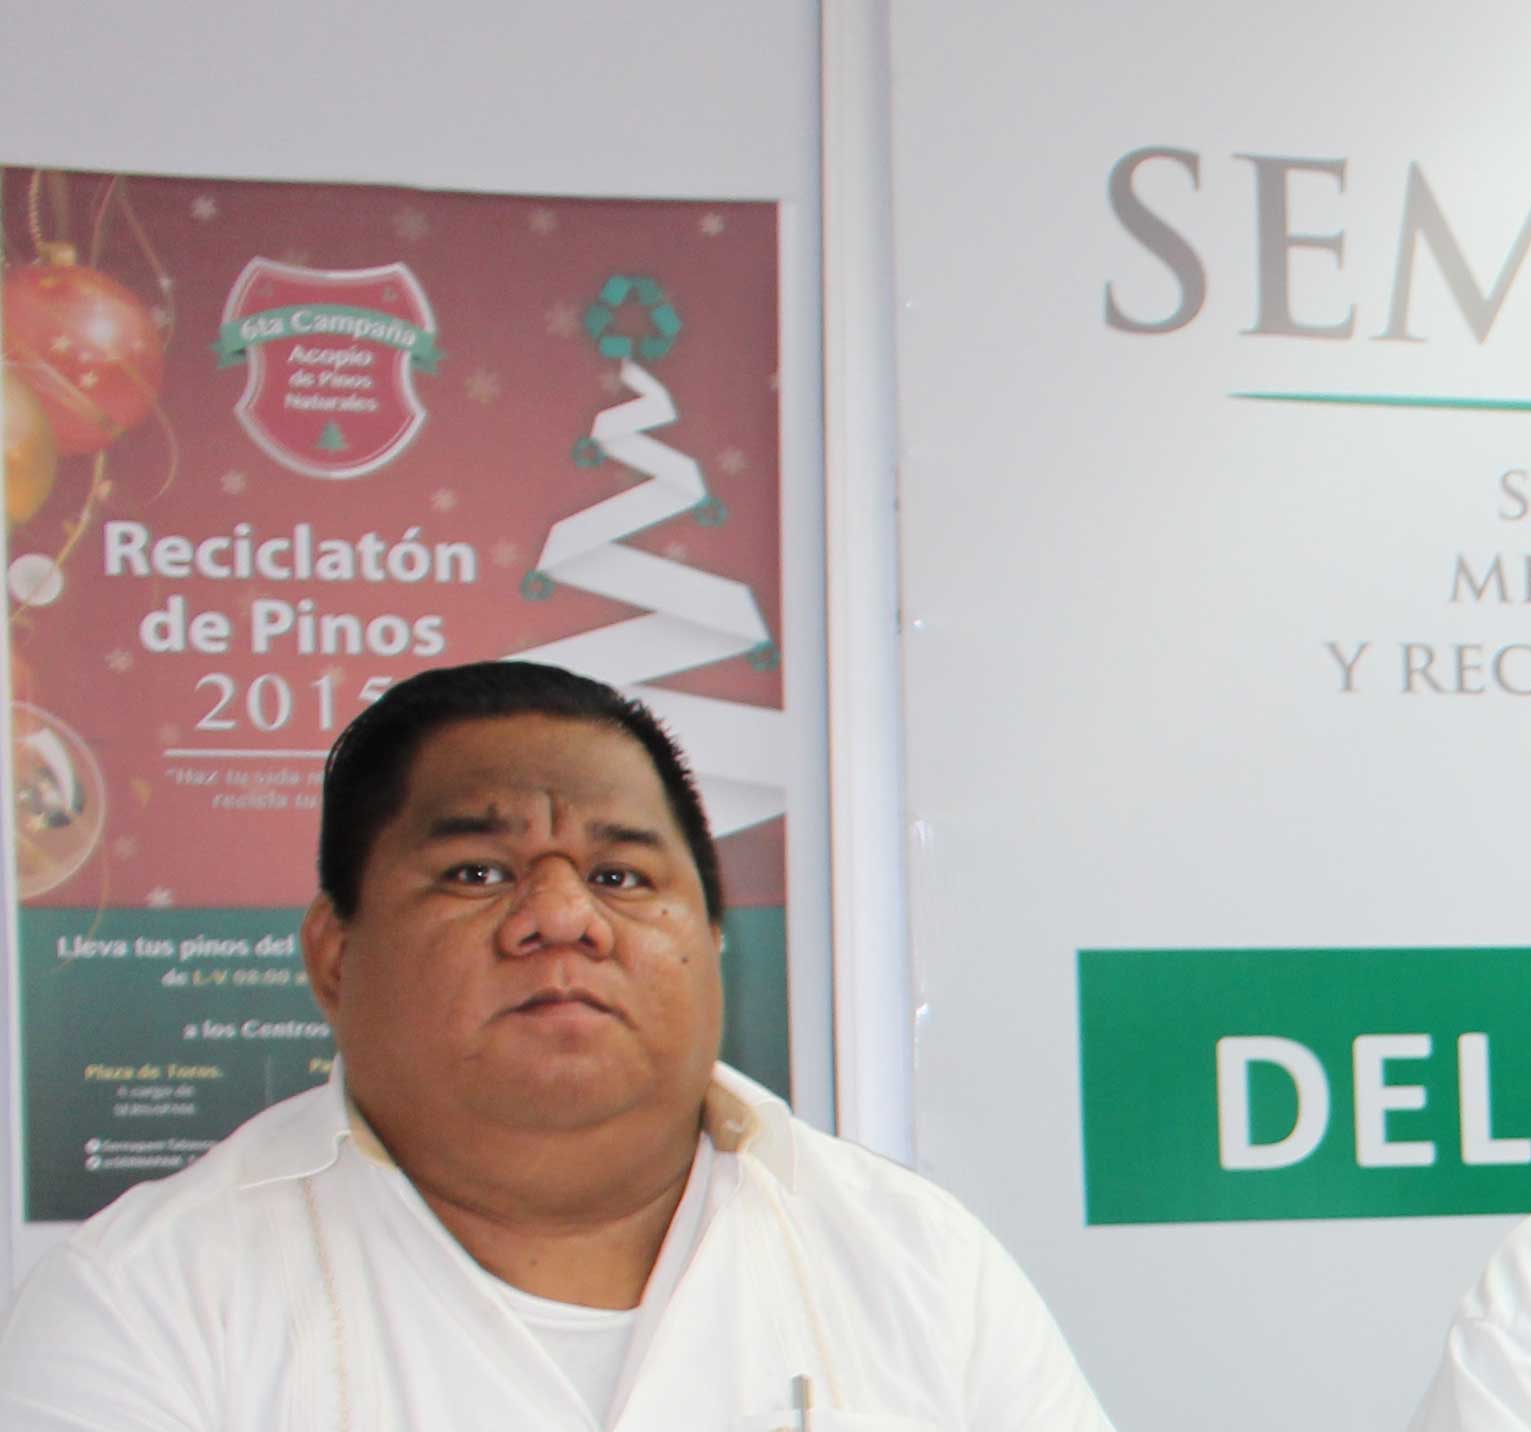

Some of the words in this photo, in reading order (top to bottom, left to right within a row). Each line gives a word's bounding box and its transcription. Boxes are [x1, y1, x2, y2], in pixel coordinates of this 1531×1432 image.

[288, 344, 373, 371] Acopio
[288, 370, 314, 388] de
[318, 371, 373, 388] Pinos
[284, 393, 379, 411] Naturales
[104, 520, 478, 584] Reciclatón
[140, 594, 230, 653] de
[252, 598, 446, 657] Pinos
[1324, 641, 1371, 694] Y
[57, 935, 129, 958] Lleva
[134, 936, 174, 957] tus
[179, 934, 249, 962] pinos
[254, 934, 295, 957] del
